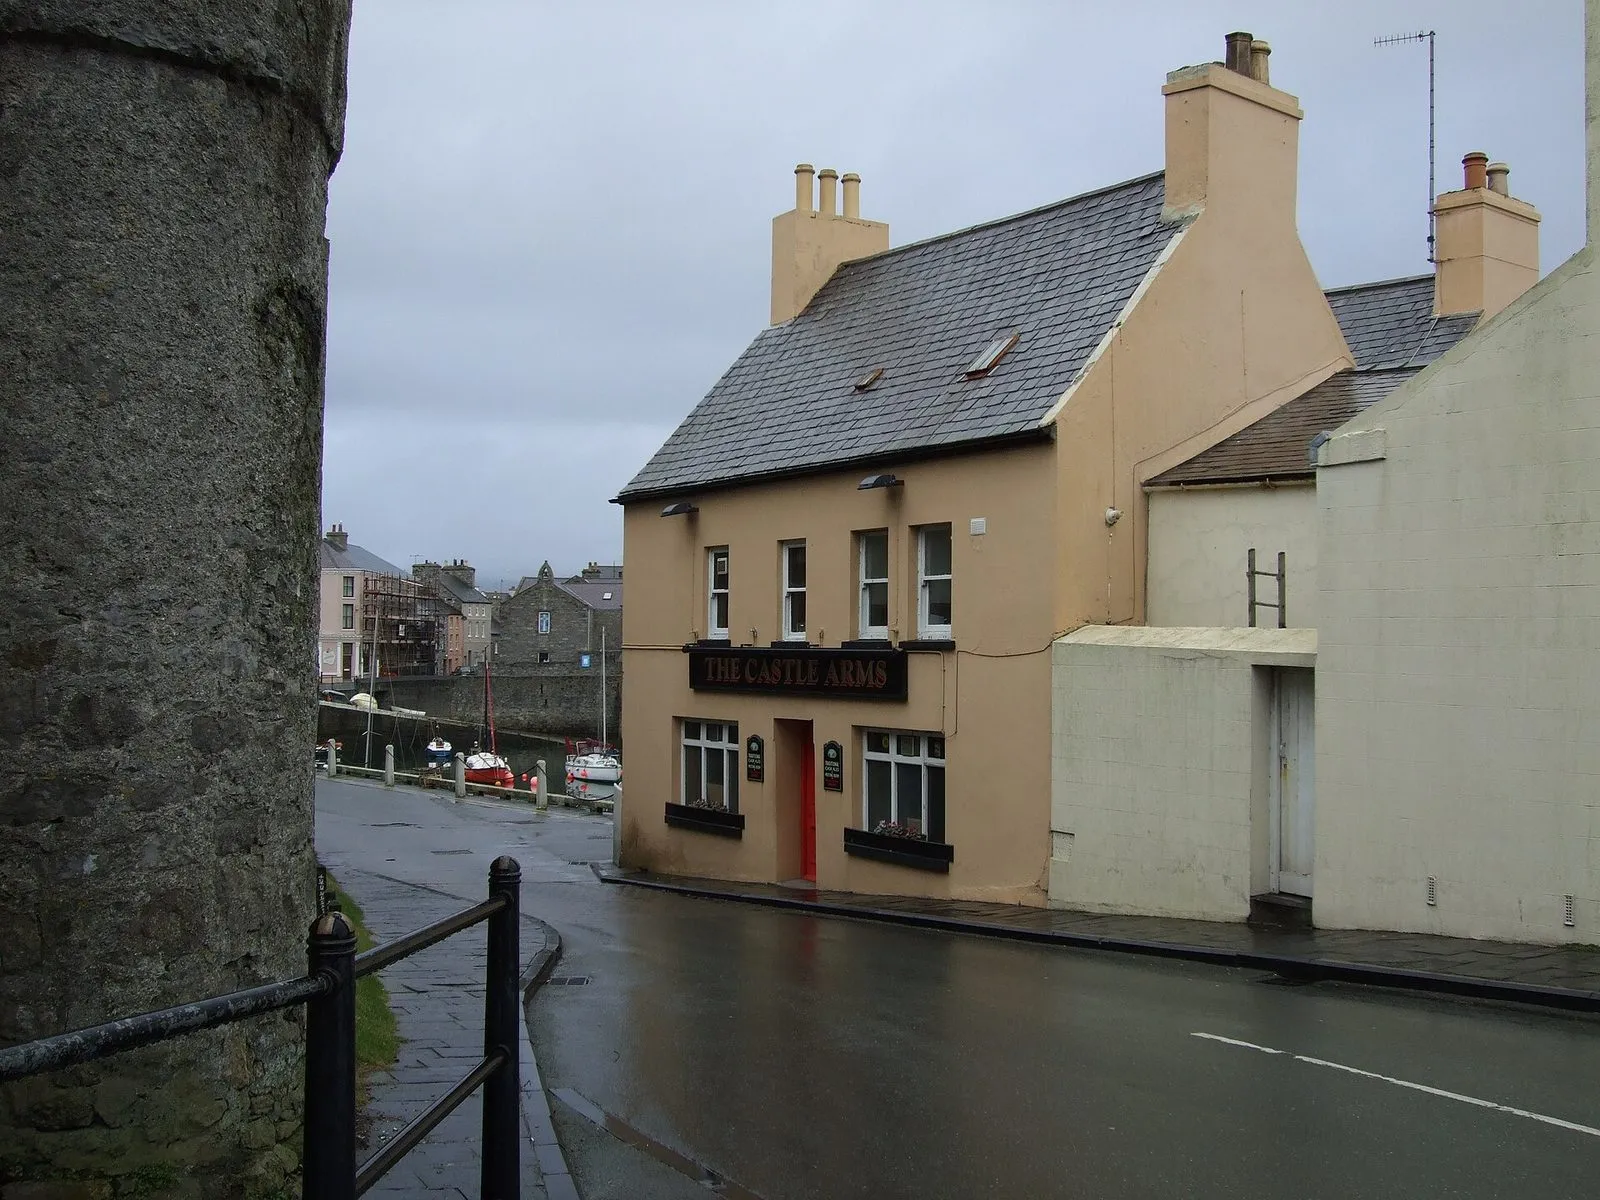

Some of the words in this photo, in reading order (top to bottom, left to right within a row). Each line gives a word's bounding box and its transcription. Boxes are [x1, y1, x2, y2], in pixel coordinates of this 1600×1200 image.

[704, 657, 741, 682] THE
[744, 658, 819, 686] CASTLE
[824, 659, 887, 688] ARMS
